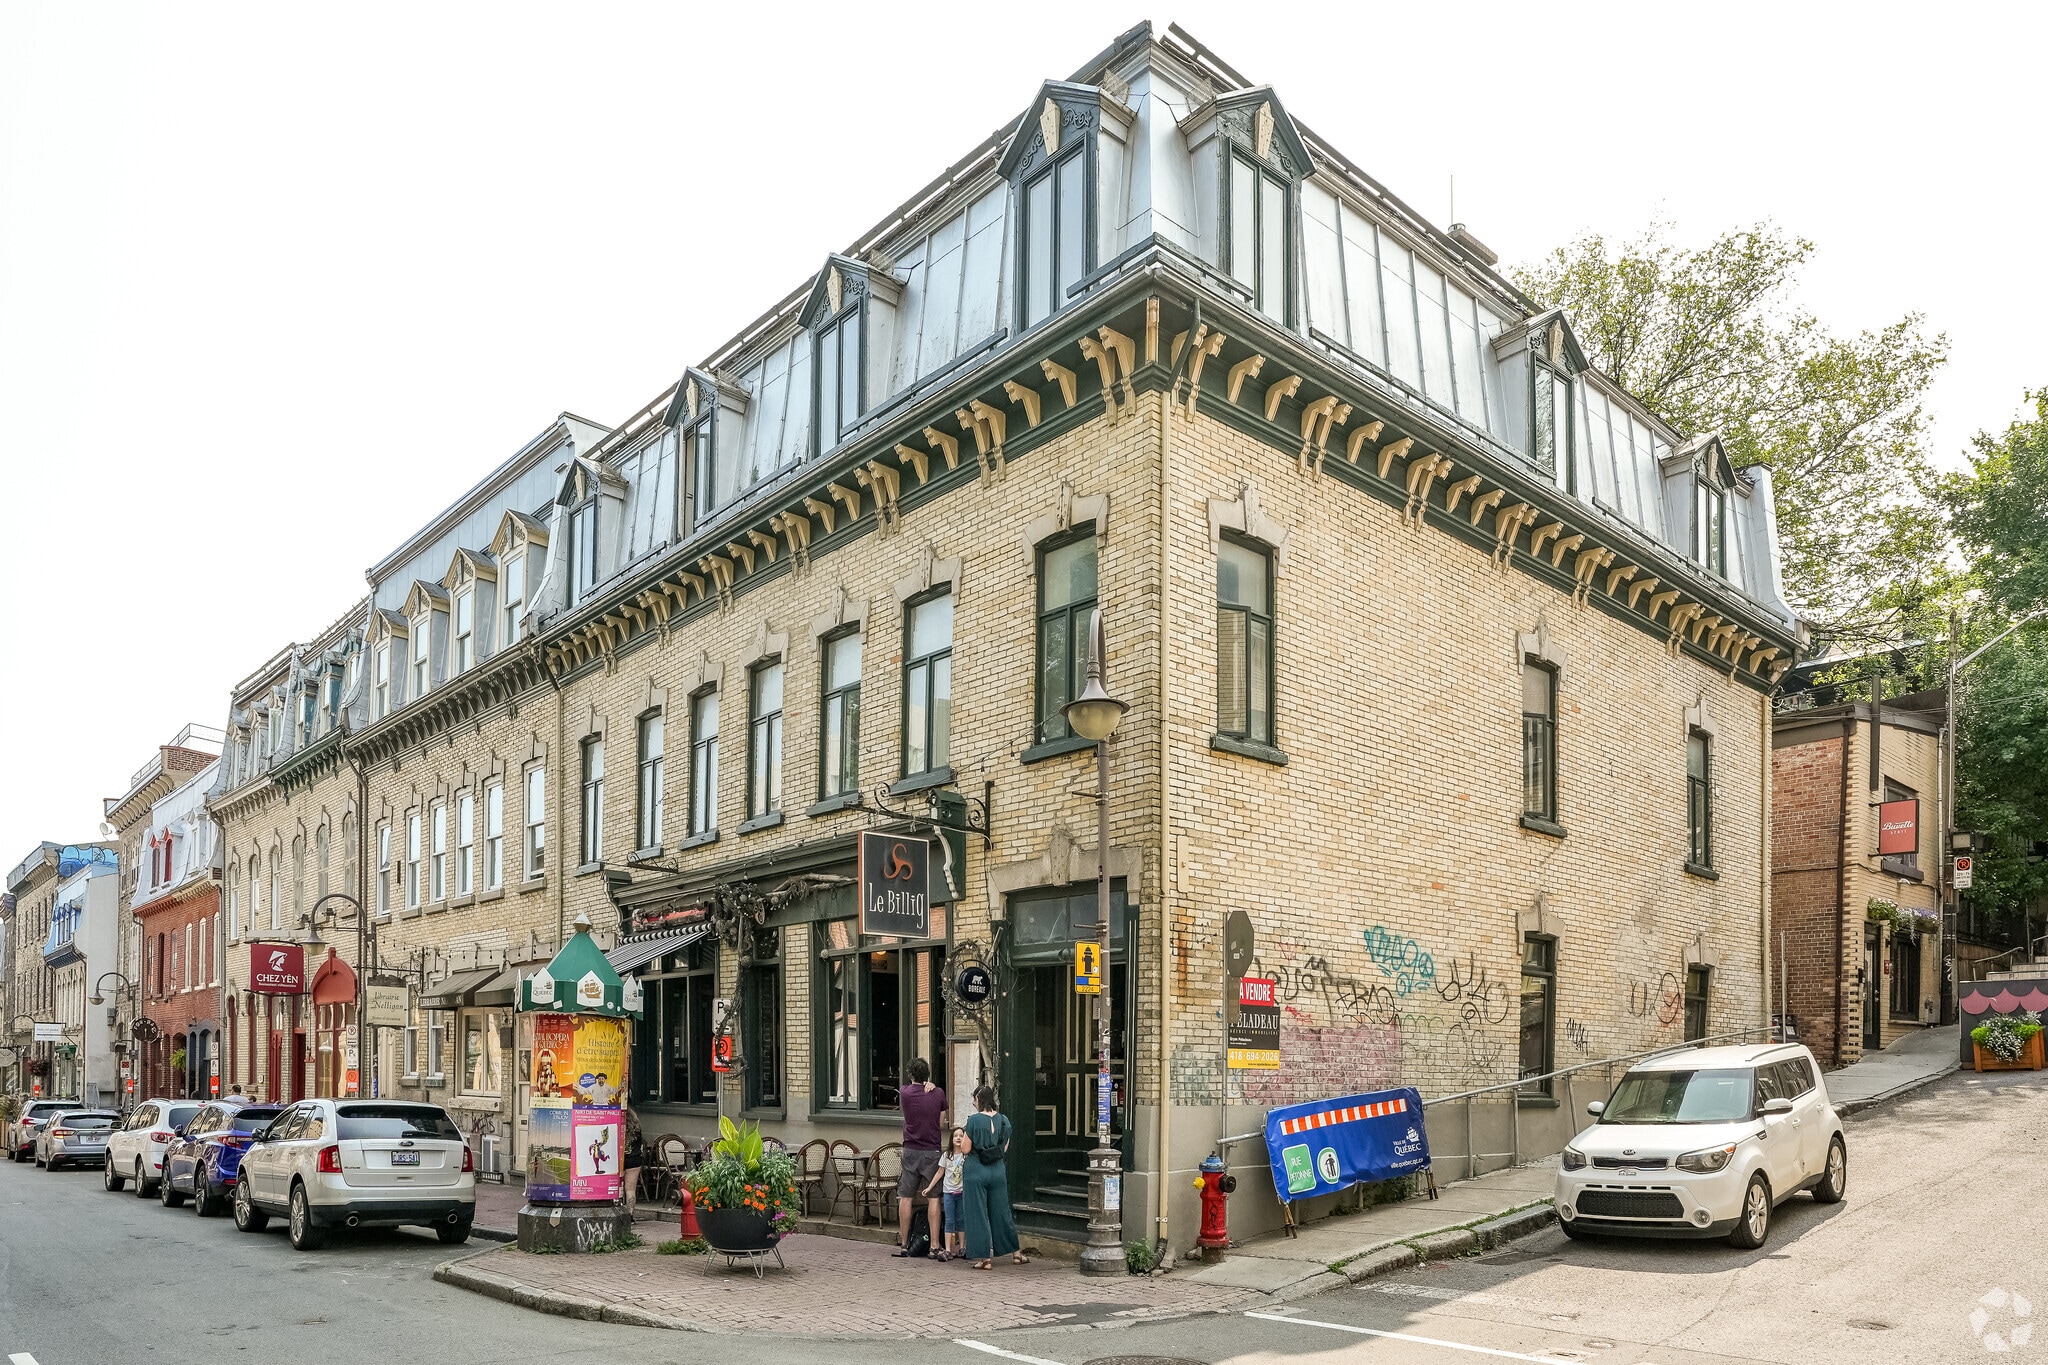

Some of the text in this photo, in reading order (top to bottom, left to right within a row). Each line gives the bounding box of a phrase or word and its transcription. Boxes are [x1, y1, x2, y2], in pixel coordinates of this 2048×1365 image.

[1881, 820, 1914, 831] Buvette
[869, 882, 925, 930] Le Billig
[256, 973, 299, 984] CHEZ YÊN
[1245, 982, 1271, 1002] VENDRE
[371, 1000, 404, 1013] Nelligan
[1394, 1143, 1422, 1157] QUÉBEC
